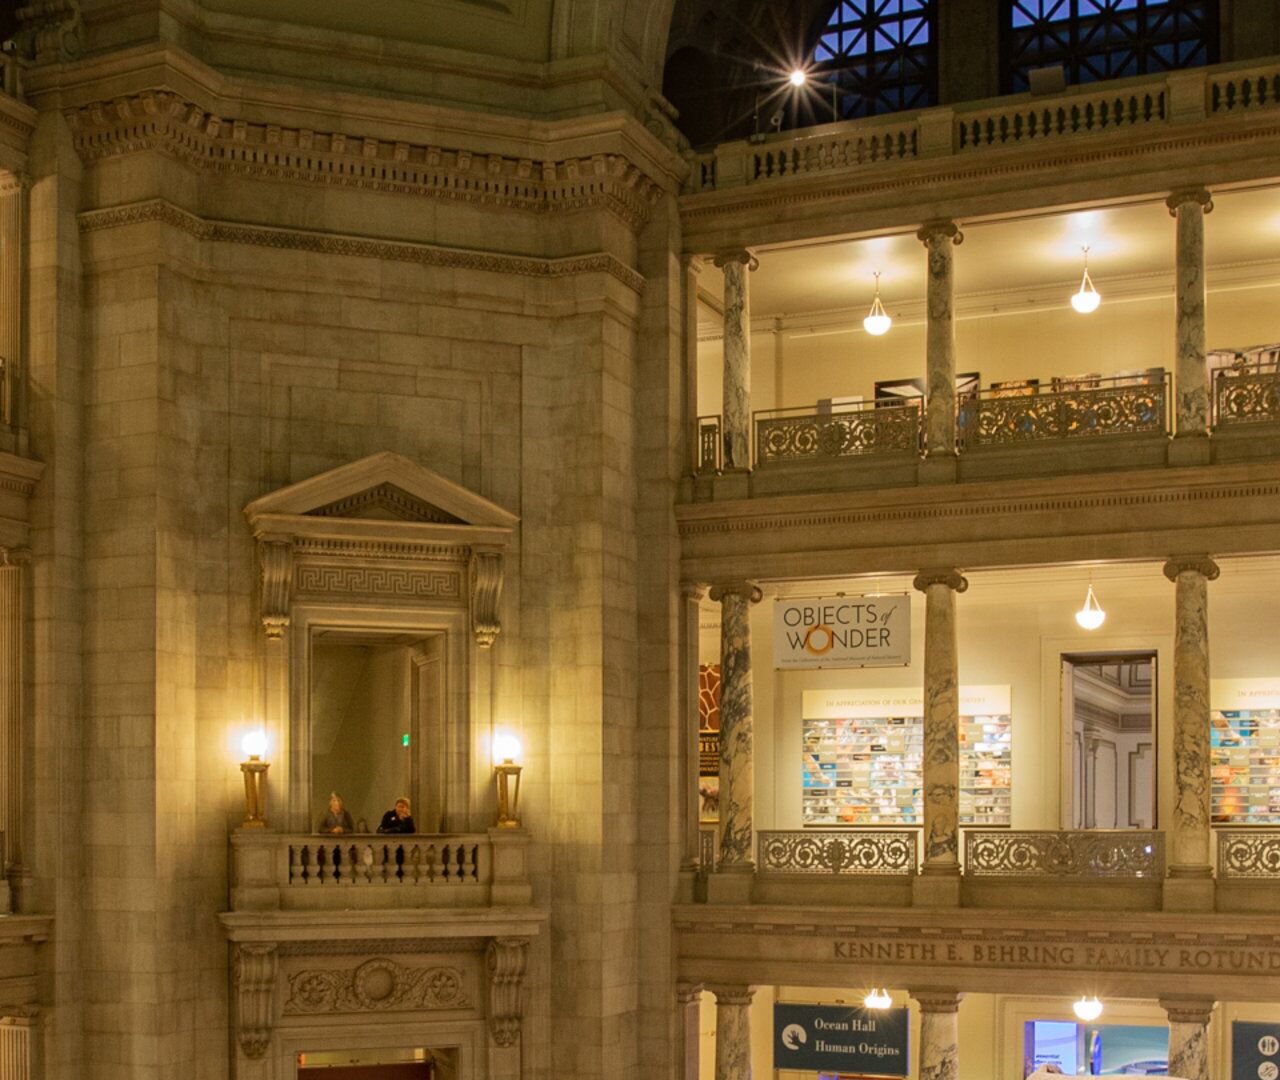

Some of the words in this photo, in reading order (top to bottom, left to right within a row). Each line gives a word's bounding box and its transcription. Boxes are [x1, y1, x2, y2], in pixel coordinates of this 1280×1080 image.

[783, 603, 877, 629] OBJECTS
[881, 605, 898, 626] of
[786, 625, 891, 656] WONDER
[833, 941, 936, 961] KENNETH
[948, 944, 962, 961] E.
[972, 945, 1075, 965] BEHRING
[1085, 949, 1169, 968] FAMILY
[814, 1018, 848, 1030] Ocean
[852, 1019, 876, 1032] Hall
[815, 1040, 856, 1054] Human
[859, 1042, 900, 1058] Origins
